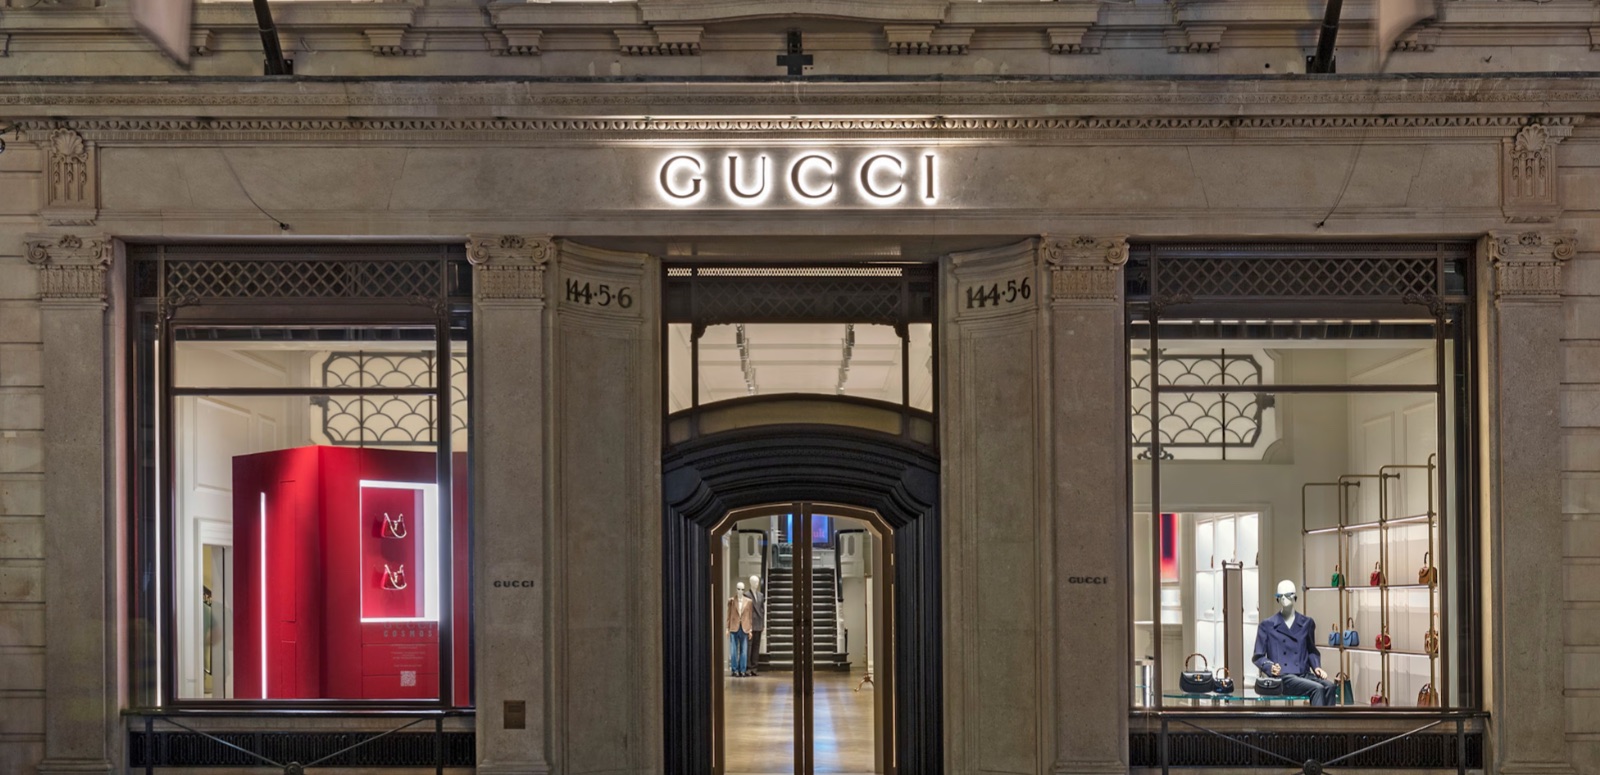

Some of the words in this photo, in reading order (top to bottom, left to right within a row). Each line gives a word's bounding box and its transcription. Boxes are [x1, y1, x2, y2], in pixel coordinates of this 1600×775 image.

[659, 154, 935, 199] GUCCI
[493, 580, 534, 588] GUCCI
[1068, 576, 1107, 585] GUCCI
[383, 629, 433, 638] COSMOS
